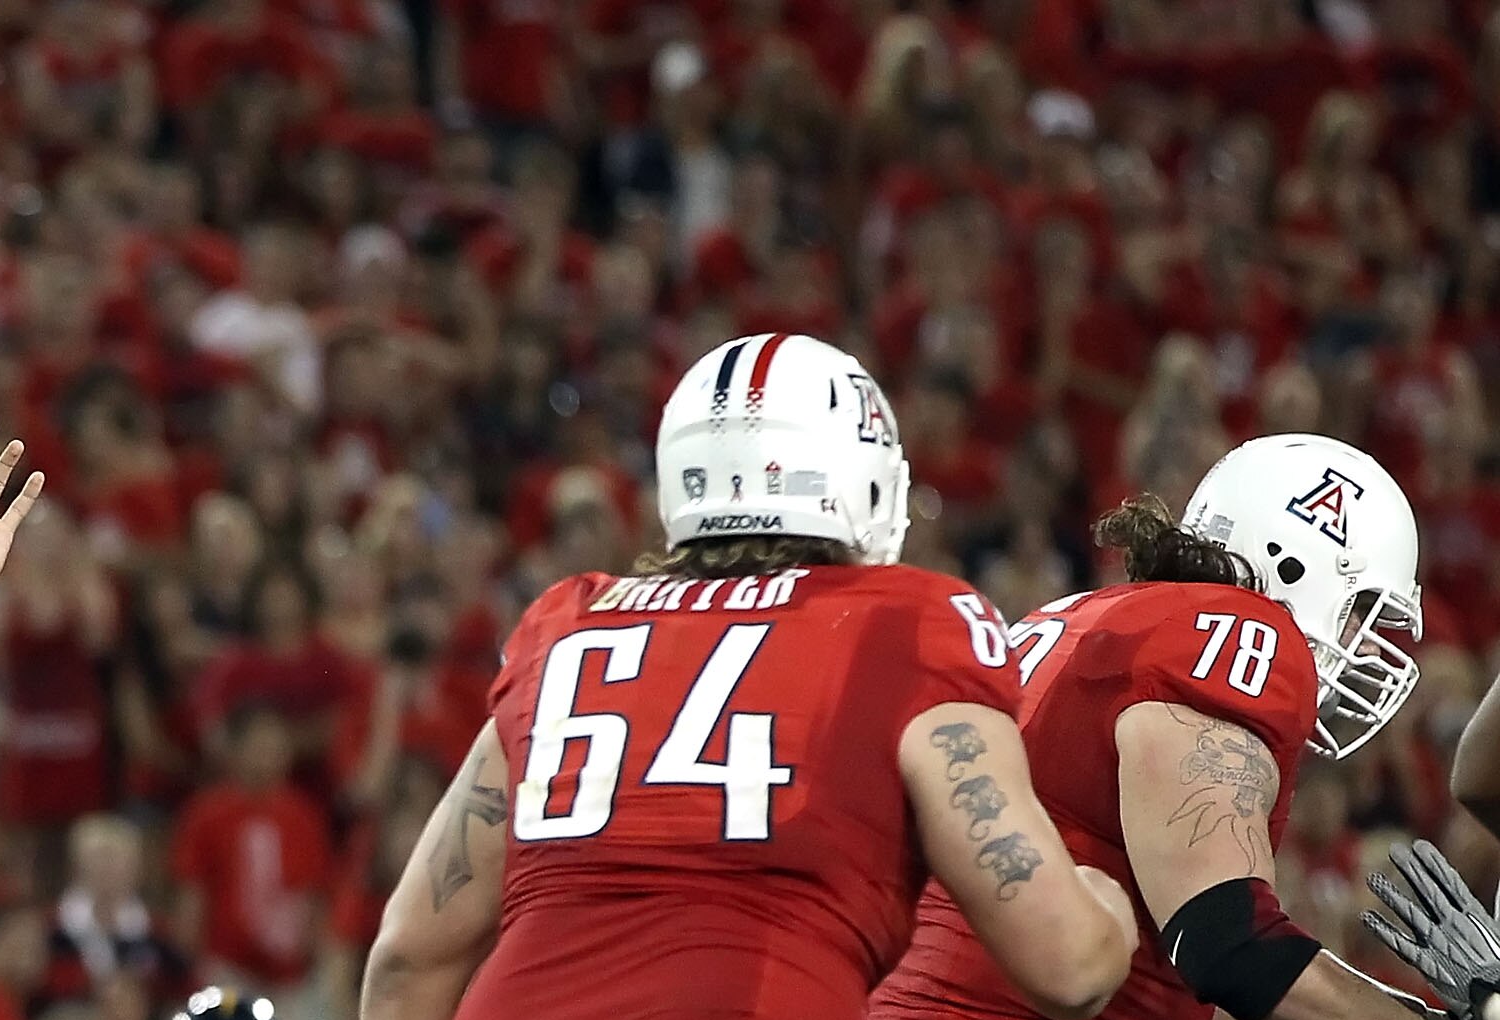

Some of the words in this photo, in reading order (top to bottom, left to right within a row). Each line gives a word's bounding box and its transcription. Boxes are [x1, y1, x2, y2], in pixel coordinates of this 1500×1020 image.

[696, 514, 784, 534] ARIZONA
[1285, 467, 1365, 548] A
[948, 591, 1008, 669] 6
[1191, 612, 1279, 698] 78
[512, 621, 794, 843] 64
